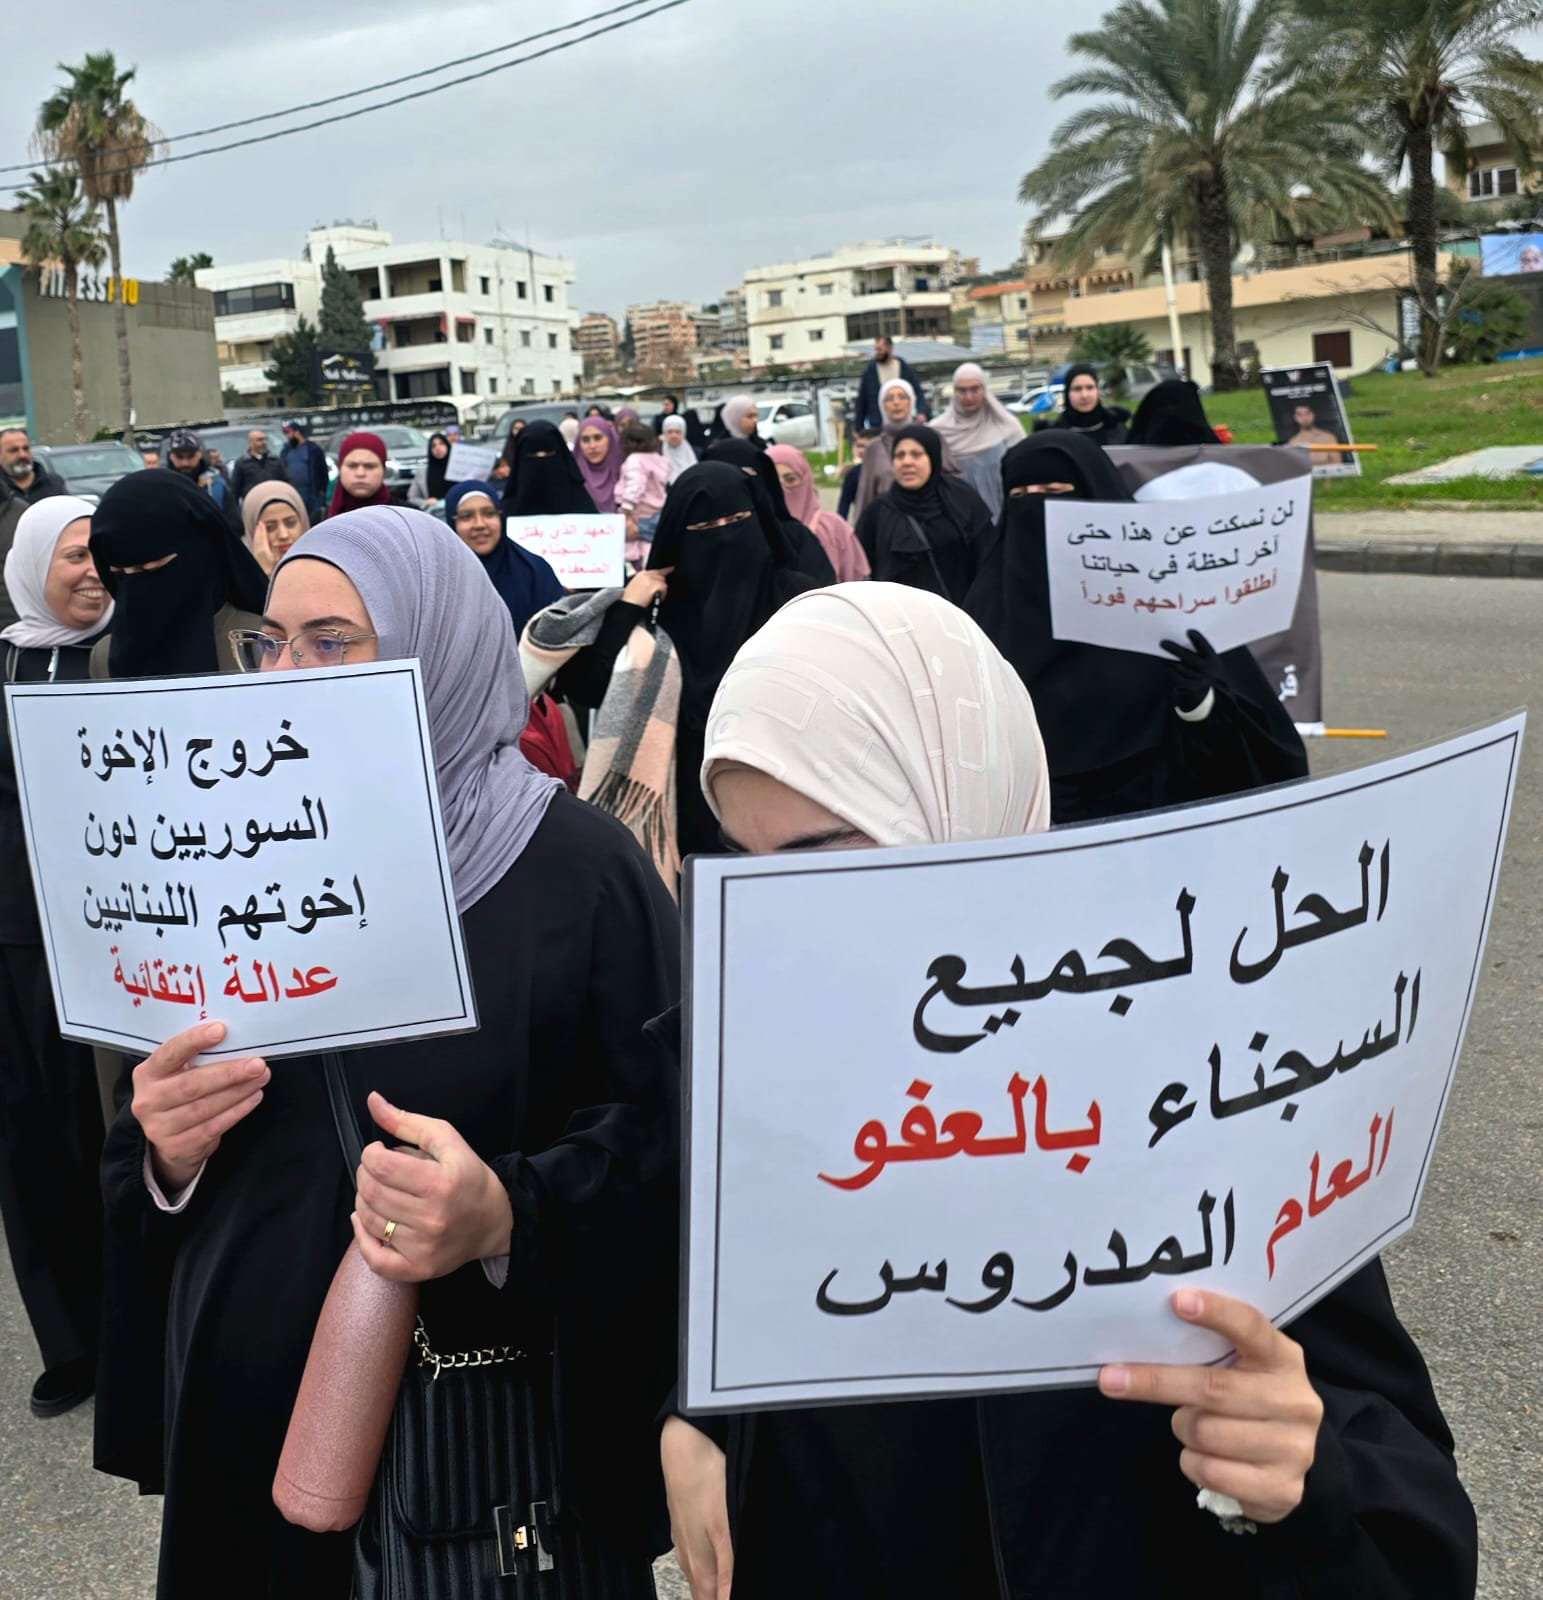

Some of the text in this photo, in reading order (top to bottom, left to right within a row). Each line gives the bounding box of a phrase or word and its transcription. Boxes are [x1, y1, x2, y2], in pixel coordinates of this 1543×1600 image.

[541, 543, 591, 556] السجناء
[584, 524, 615, 538] العهد
[1067, 499, 1294, 546] لن نسكت عن هذا حتى
[1081, 534, 1279, 583] آخر لحظة في حياتنا
[1133, 592, 1216, 614] سراحهم
[78, 720, 309, 789] خروج الإخوة
[85, 795, 328, 861] السوريين دون
[84, 874, 368, 948] إخوتهم اللبنانيين
[913, 838, 1389, 1053] الحل لجميع
[110, 946, 338, 1020] عدالة إنتقائية
[818, 967, 1421, 1190] السجناء بالعفو
[816, 1107, 1394, 1314] العام المدروس
